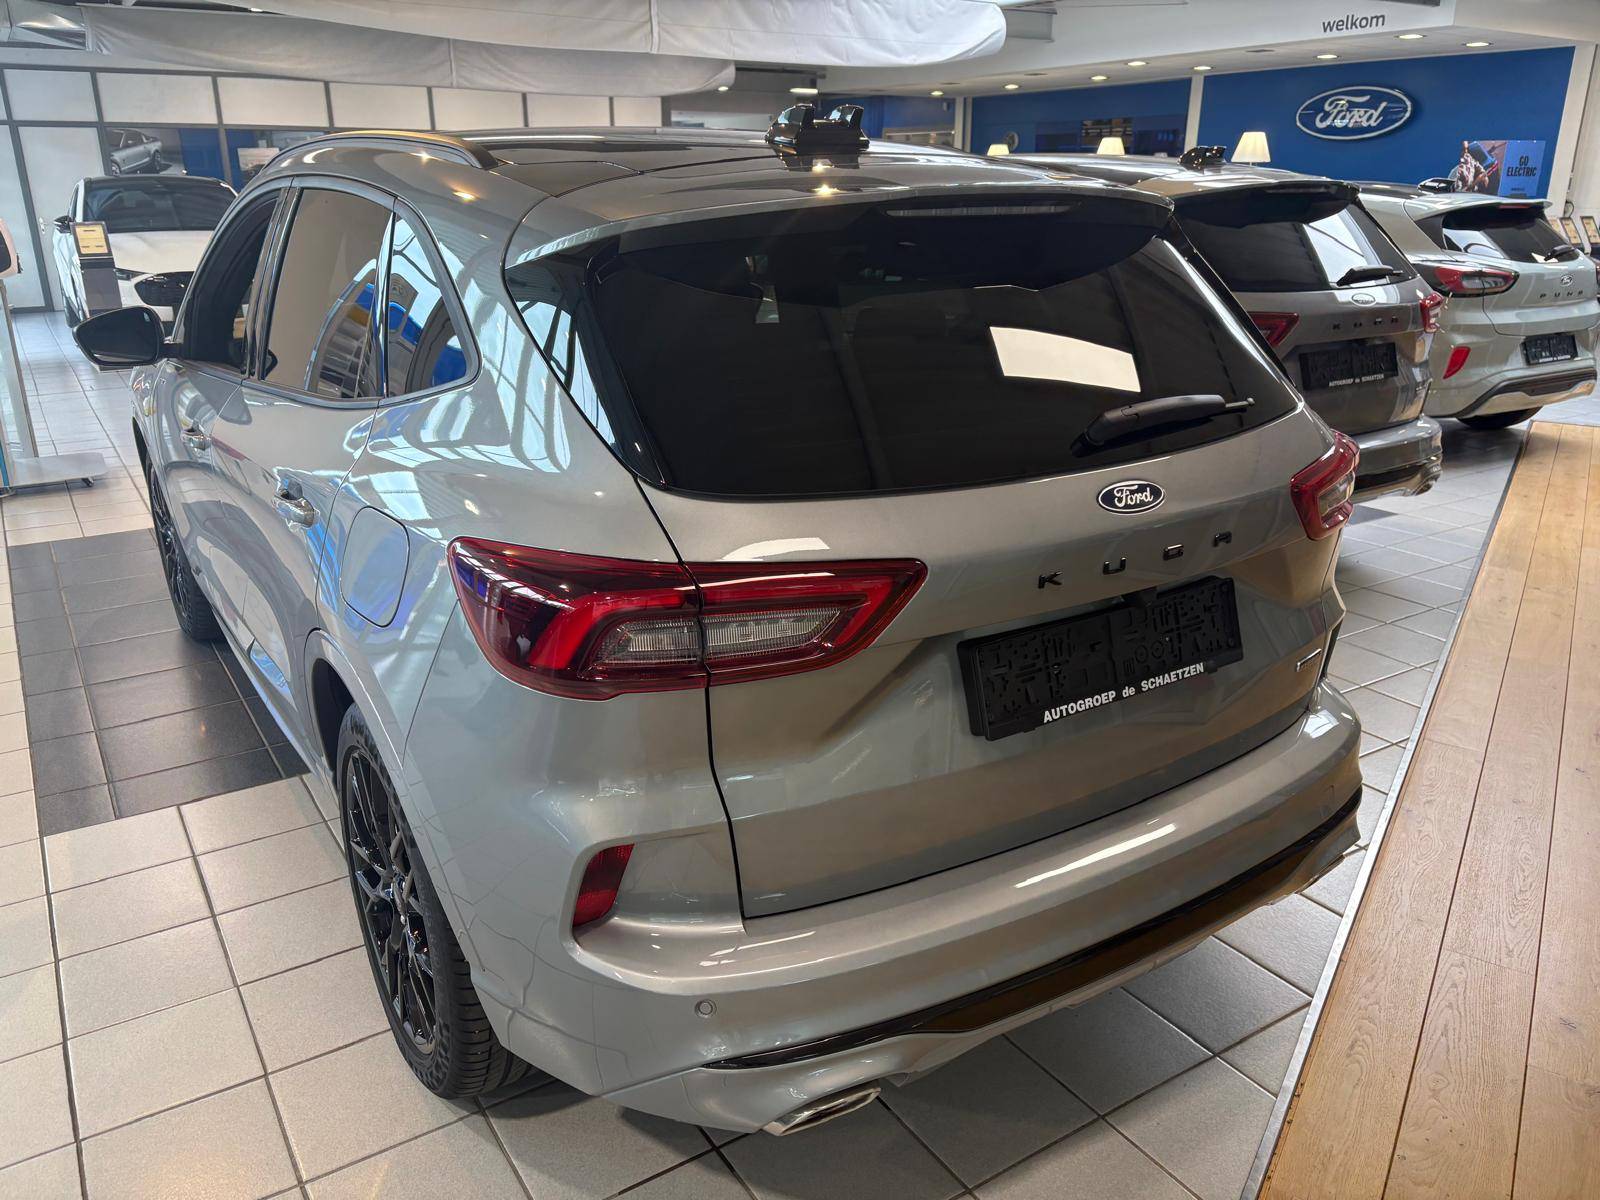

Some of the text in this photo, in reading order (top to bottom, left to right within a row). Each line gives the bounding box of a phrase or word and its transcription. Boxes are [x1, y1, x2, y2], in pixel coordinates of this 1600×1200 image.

[1322, 13, 1386, 33] welkom
[1315, 94, 1388, 129] Ford
[1506, 166, 1537, 177] ELECTRIC
[1519, 155, 1529, 166] GO
[1114, 484, 1154, 507] Ford
[1038, 531, 1233, 589] KUGA
[1043, 662, 1205, 724] AUTOGROEP de SCHAETZEN
